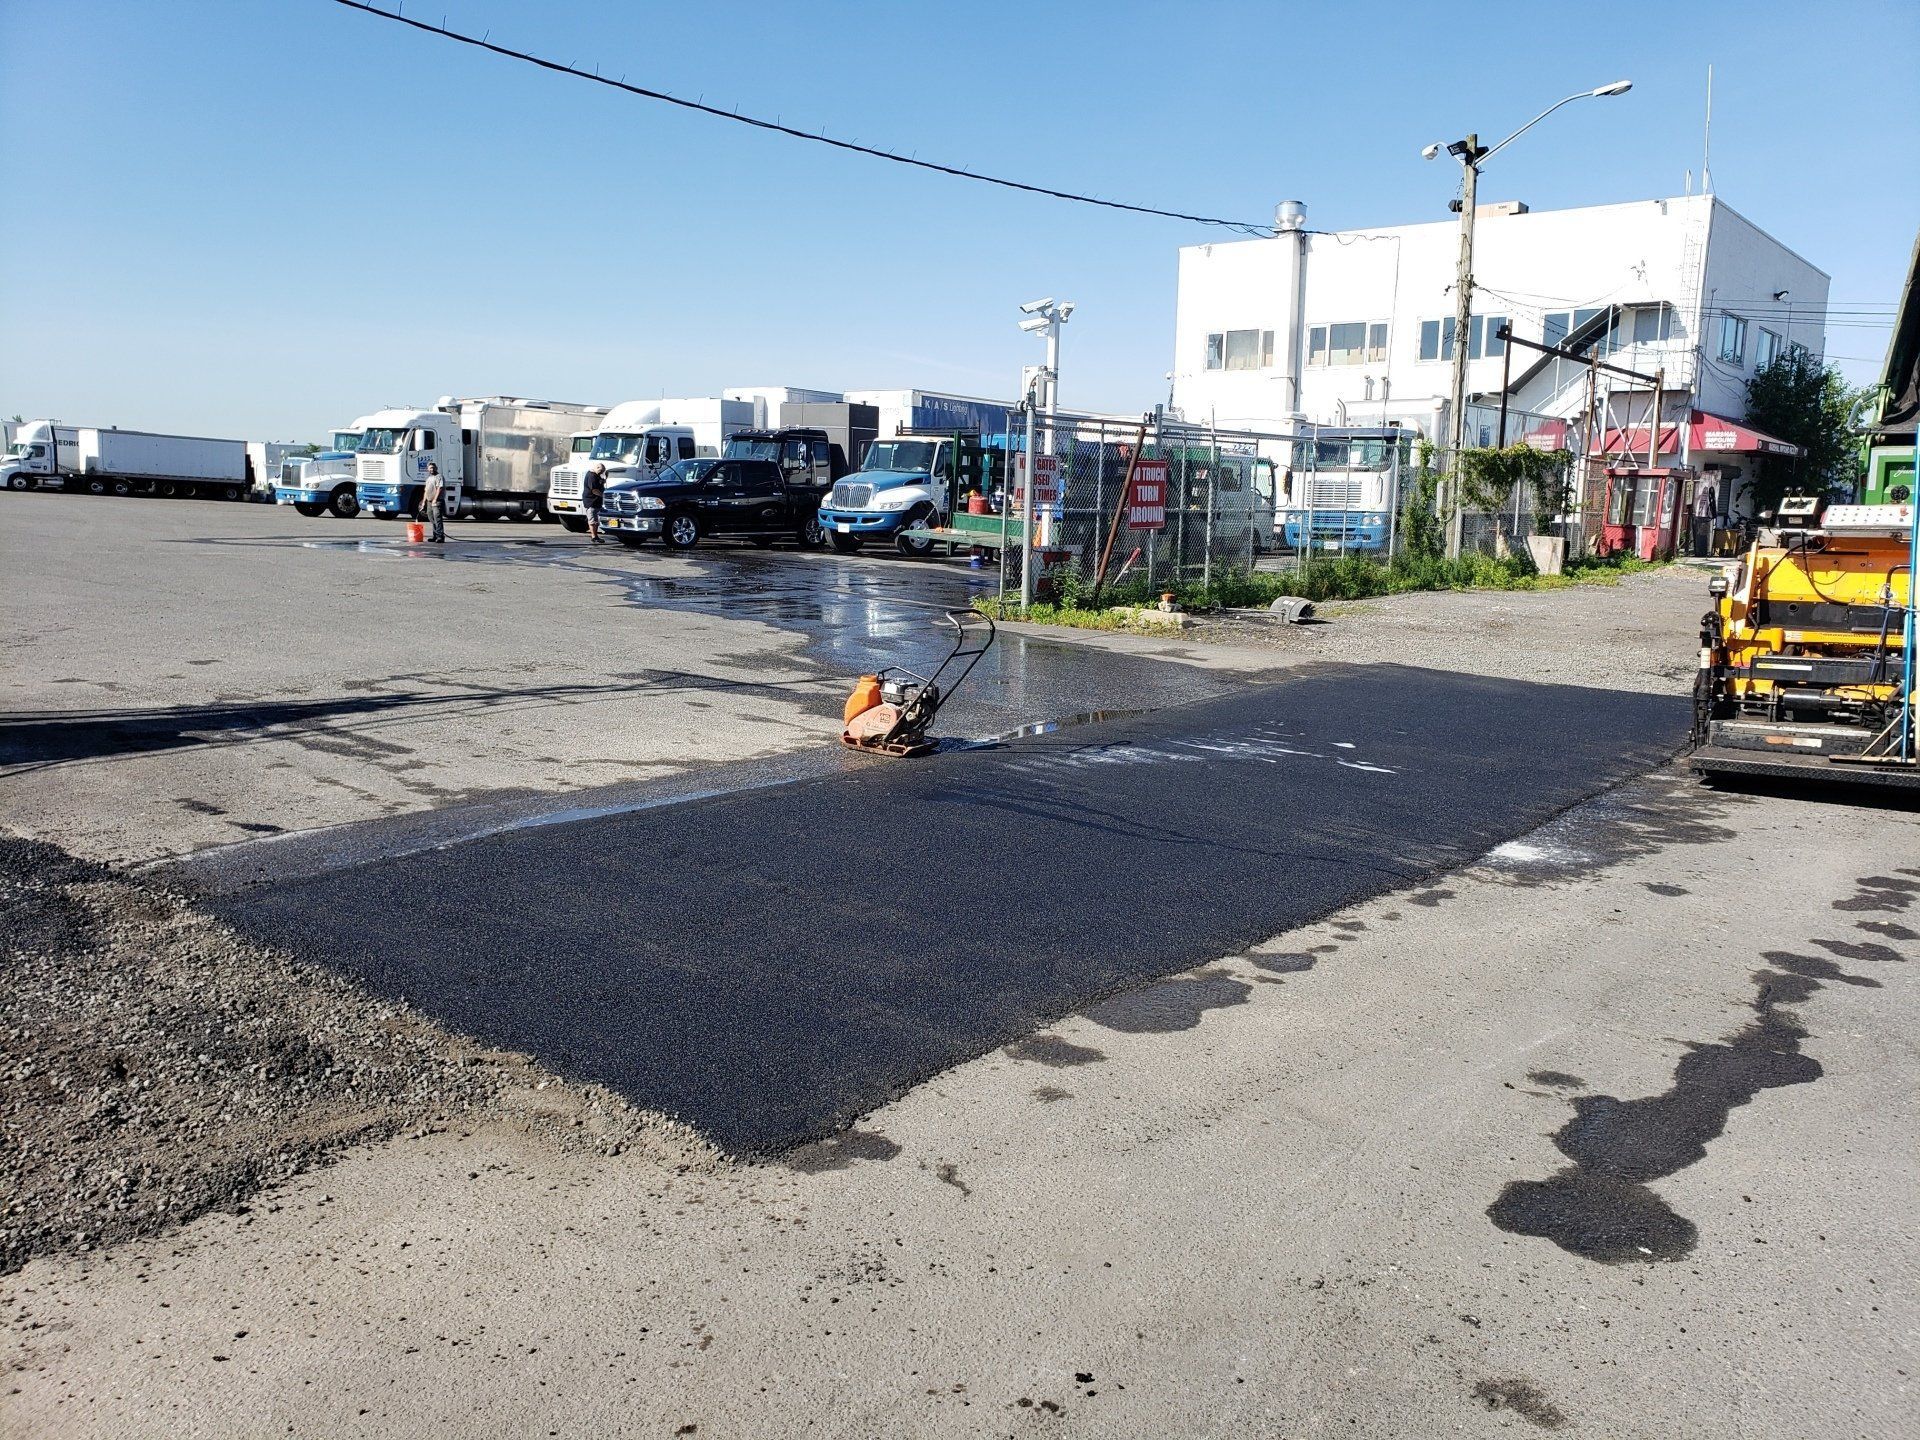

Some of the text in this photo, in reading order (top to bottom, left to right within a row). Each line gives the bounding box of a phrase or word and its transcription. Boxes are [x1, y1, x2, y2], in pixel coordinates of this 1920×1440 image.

[1037, 458, 1057, 471] GATES
[1142, 467, 1165, 481] TRUCK
[1037, 489, 1057, 501] TIMES
[1136, 485, 1159, 502] TURN
[1130, 506, 1164, 523] AROUND
